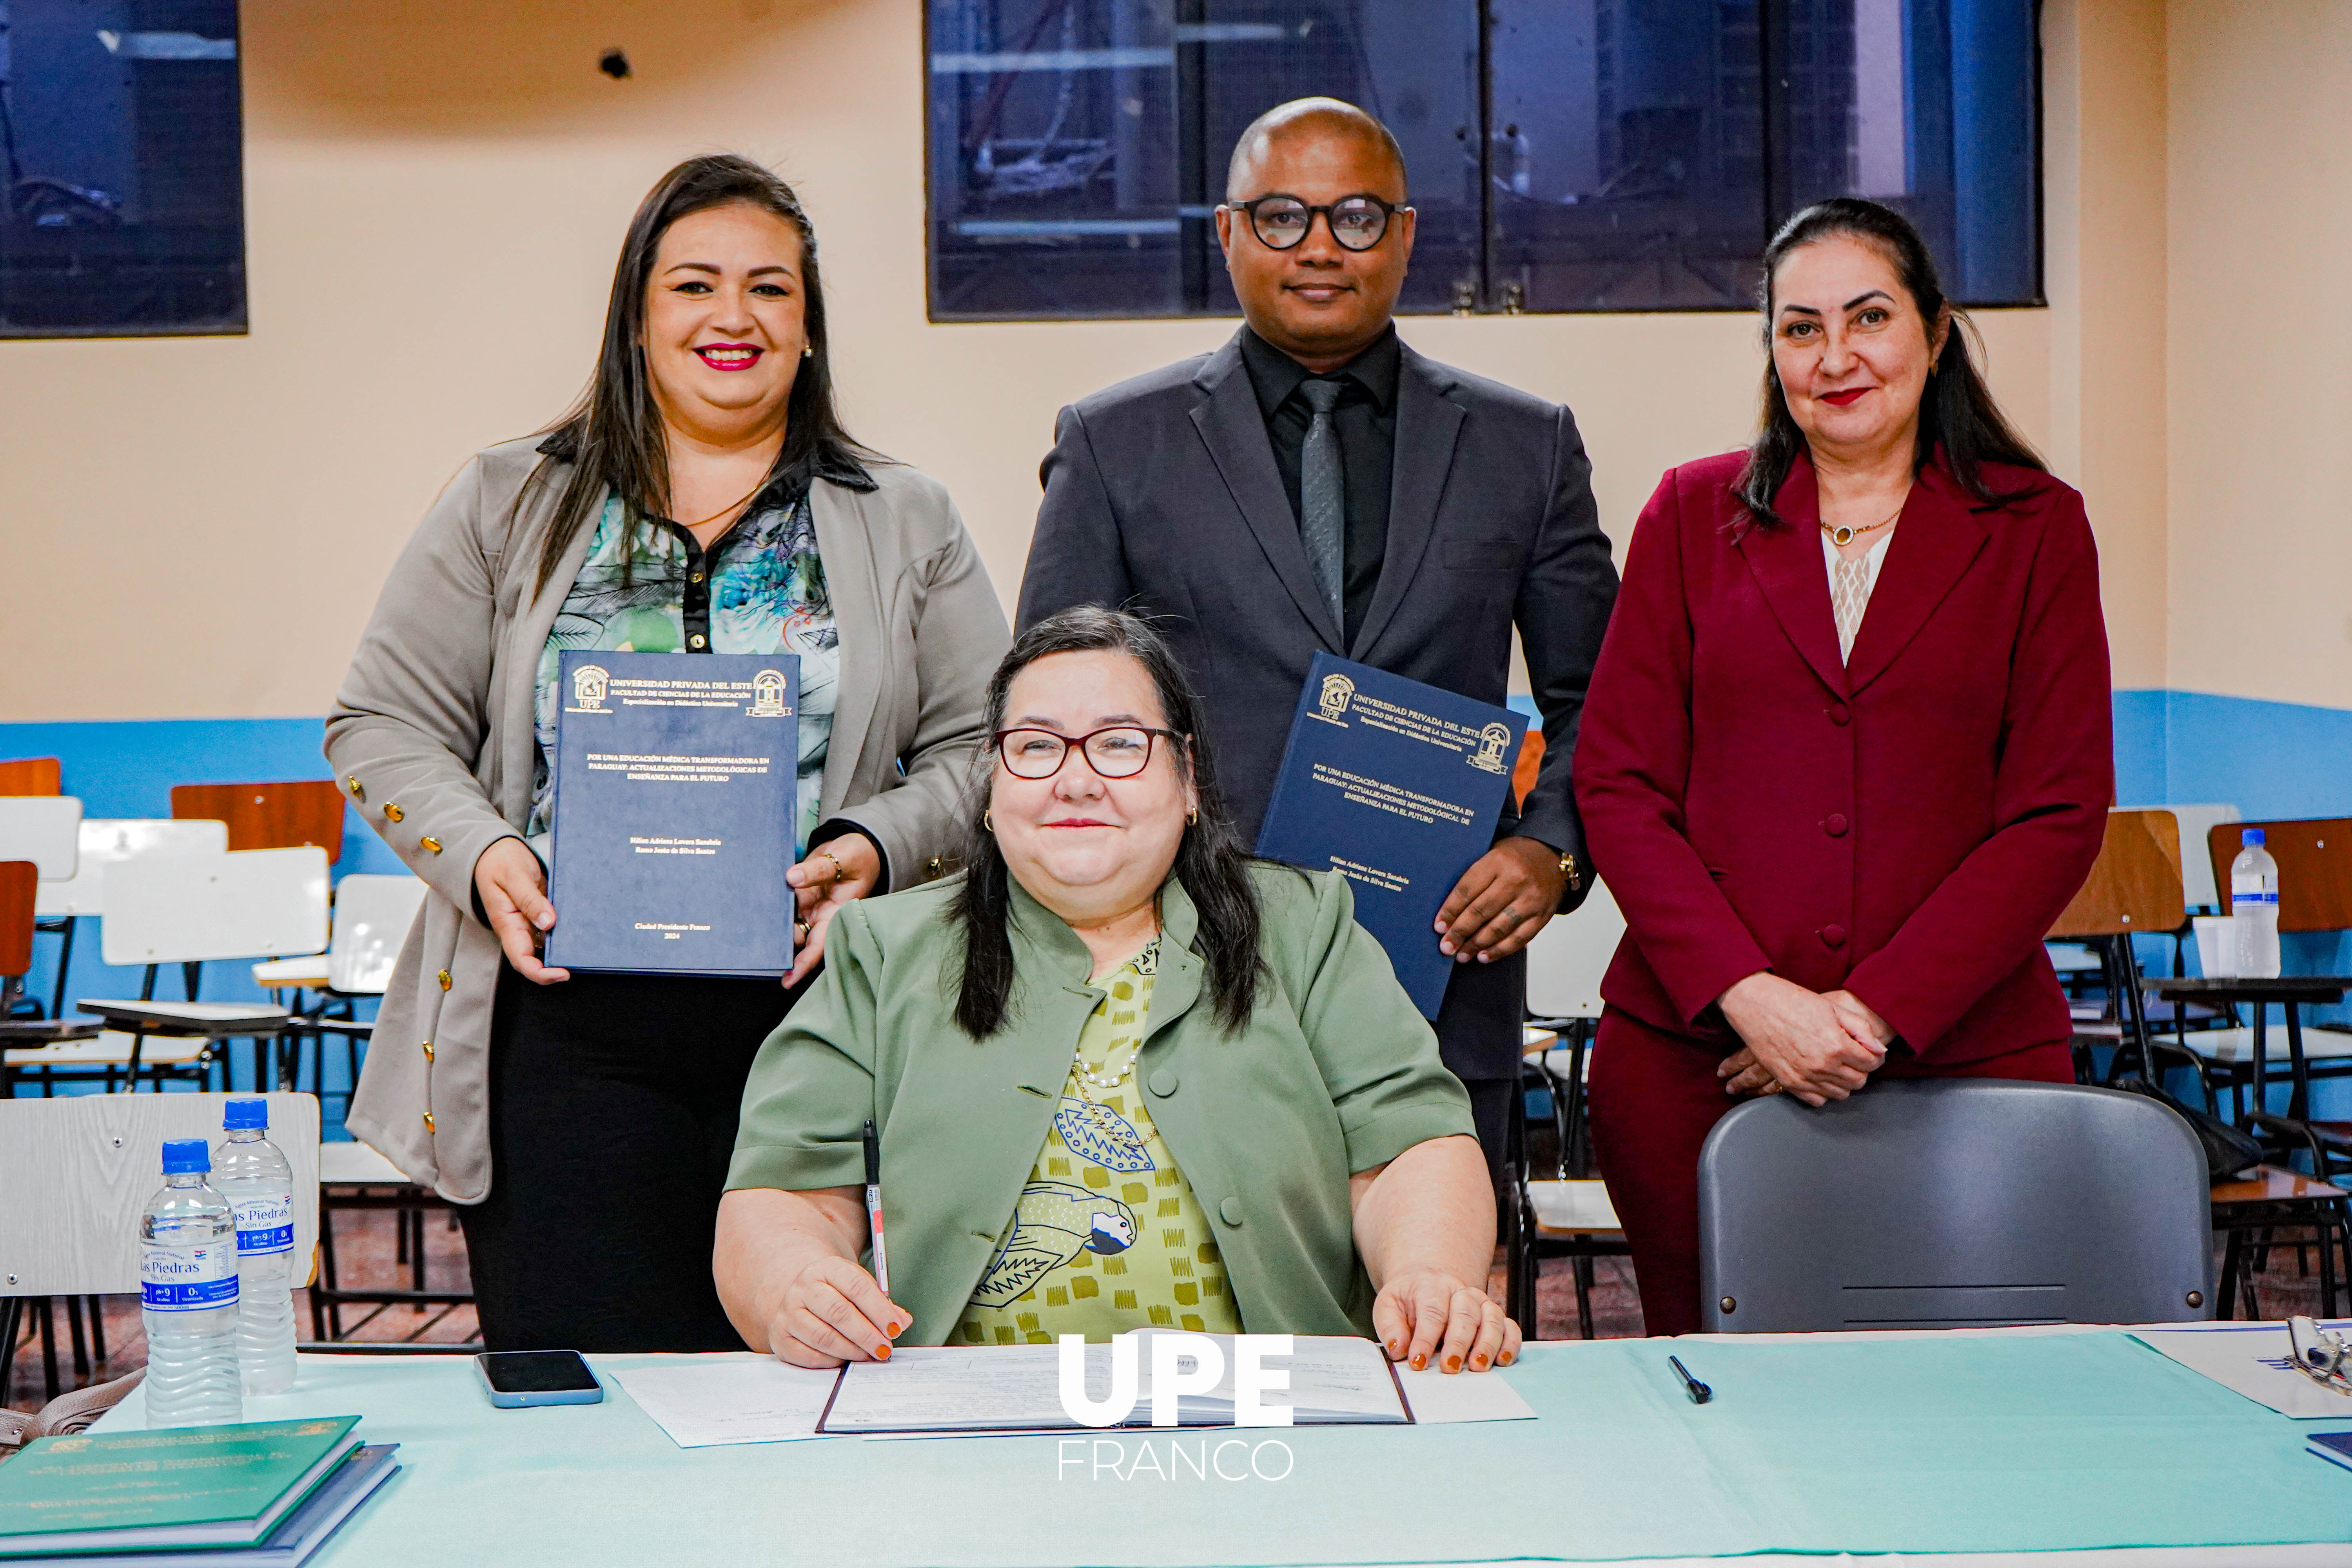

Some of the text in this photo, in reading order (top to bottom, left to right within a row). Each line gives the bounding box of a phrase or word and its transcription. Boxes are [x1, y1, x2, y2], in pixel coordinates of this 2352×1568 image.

[610, 679, 671, 688] UNIVERSIDAD
[671, 681, 711, 689] PRIVADA
[579, 700, 600, 709] UPE
[1321, 707, 1339, 720] UPE
[1354, 693, 1407, 715] UNIVERSIDAD
[1408, 710, 1442, 728] PRIVADA
[1444, 721, 1459, 732] DEL
[1461, 726, 1480, 739] ESTE
[1352, 704, 1384, 718] FACULTAD
[1384, 713, 1393, 722] DE
[1394, 716, 1422, 730] CIENCIAS
[1422, 725, 1431, 734] DE
[1431, 728, 1440, 736] LA
[1441, 730, 1476, 746] EDUCACIÓN
[1430, 737, 1462, 752] Universitaria
[1314, 763, 1474, 817] POR UNA EDUCACIÓN MÉDICA TRANSFORMADORA EN
[1312, 773, 1348, 789] PARAGUAY:
[1348, 784, 1406, 806] ACTUALIZACIONES
[1461, 817, 1470, 825] DE
[1344, 791, 1434, 824] ENSEÑANZA PARA EL FUTURO
[249, 1208, 288, 1221] Piedras
[167, 1252, 185, 1260] Natural
[152, 1261, 200, 1274] Piedras
